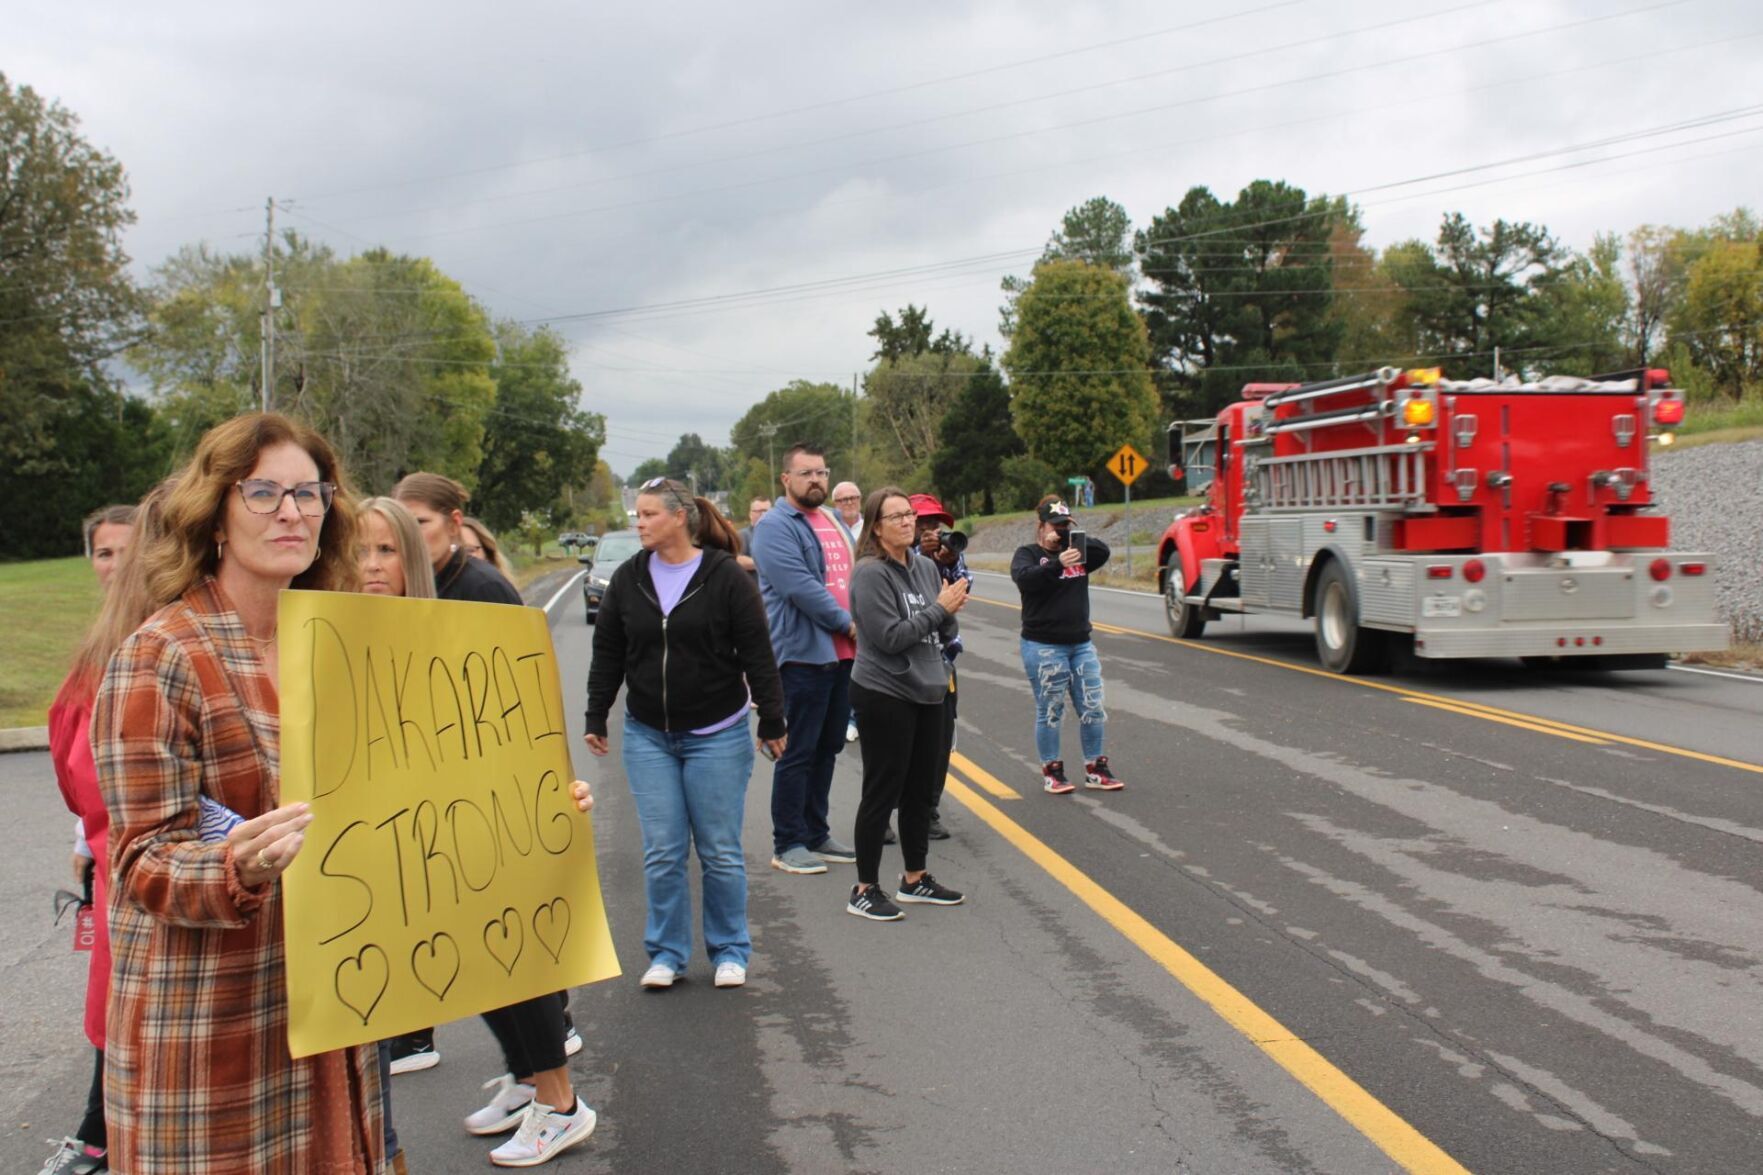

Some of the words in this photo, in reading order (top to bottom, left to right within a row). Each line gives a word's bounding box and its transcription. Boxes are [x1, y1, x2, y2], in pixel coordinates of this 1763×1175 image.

[828, 552, 841, 560] TO
[303, 617, 563, 799] DAKARAI
[319, 770, 573, 945] STRONG
